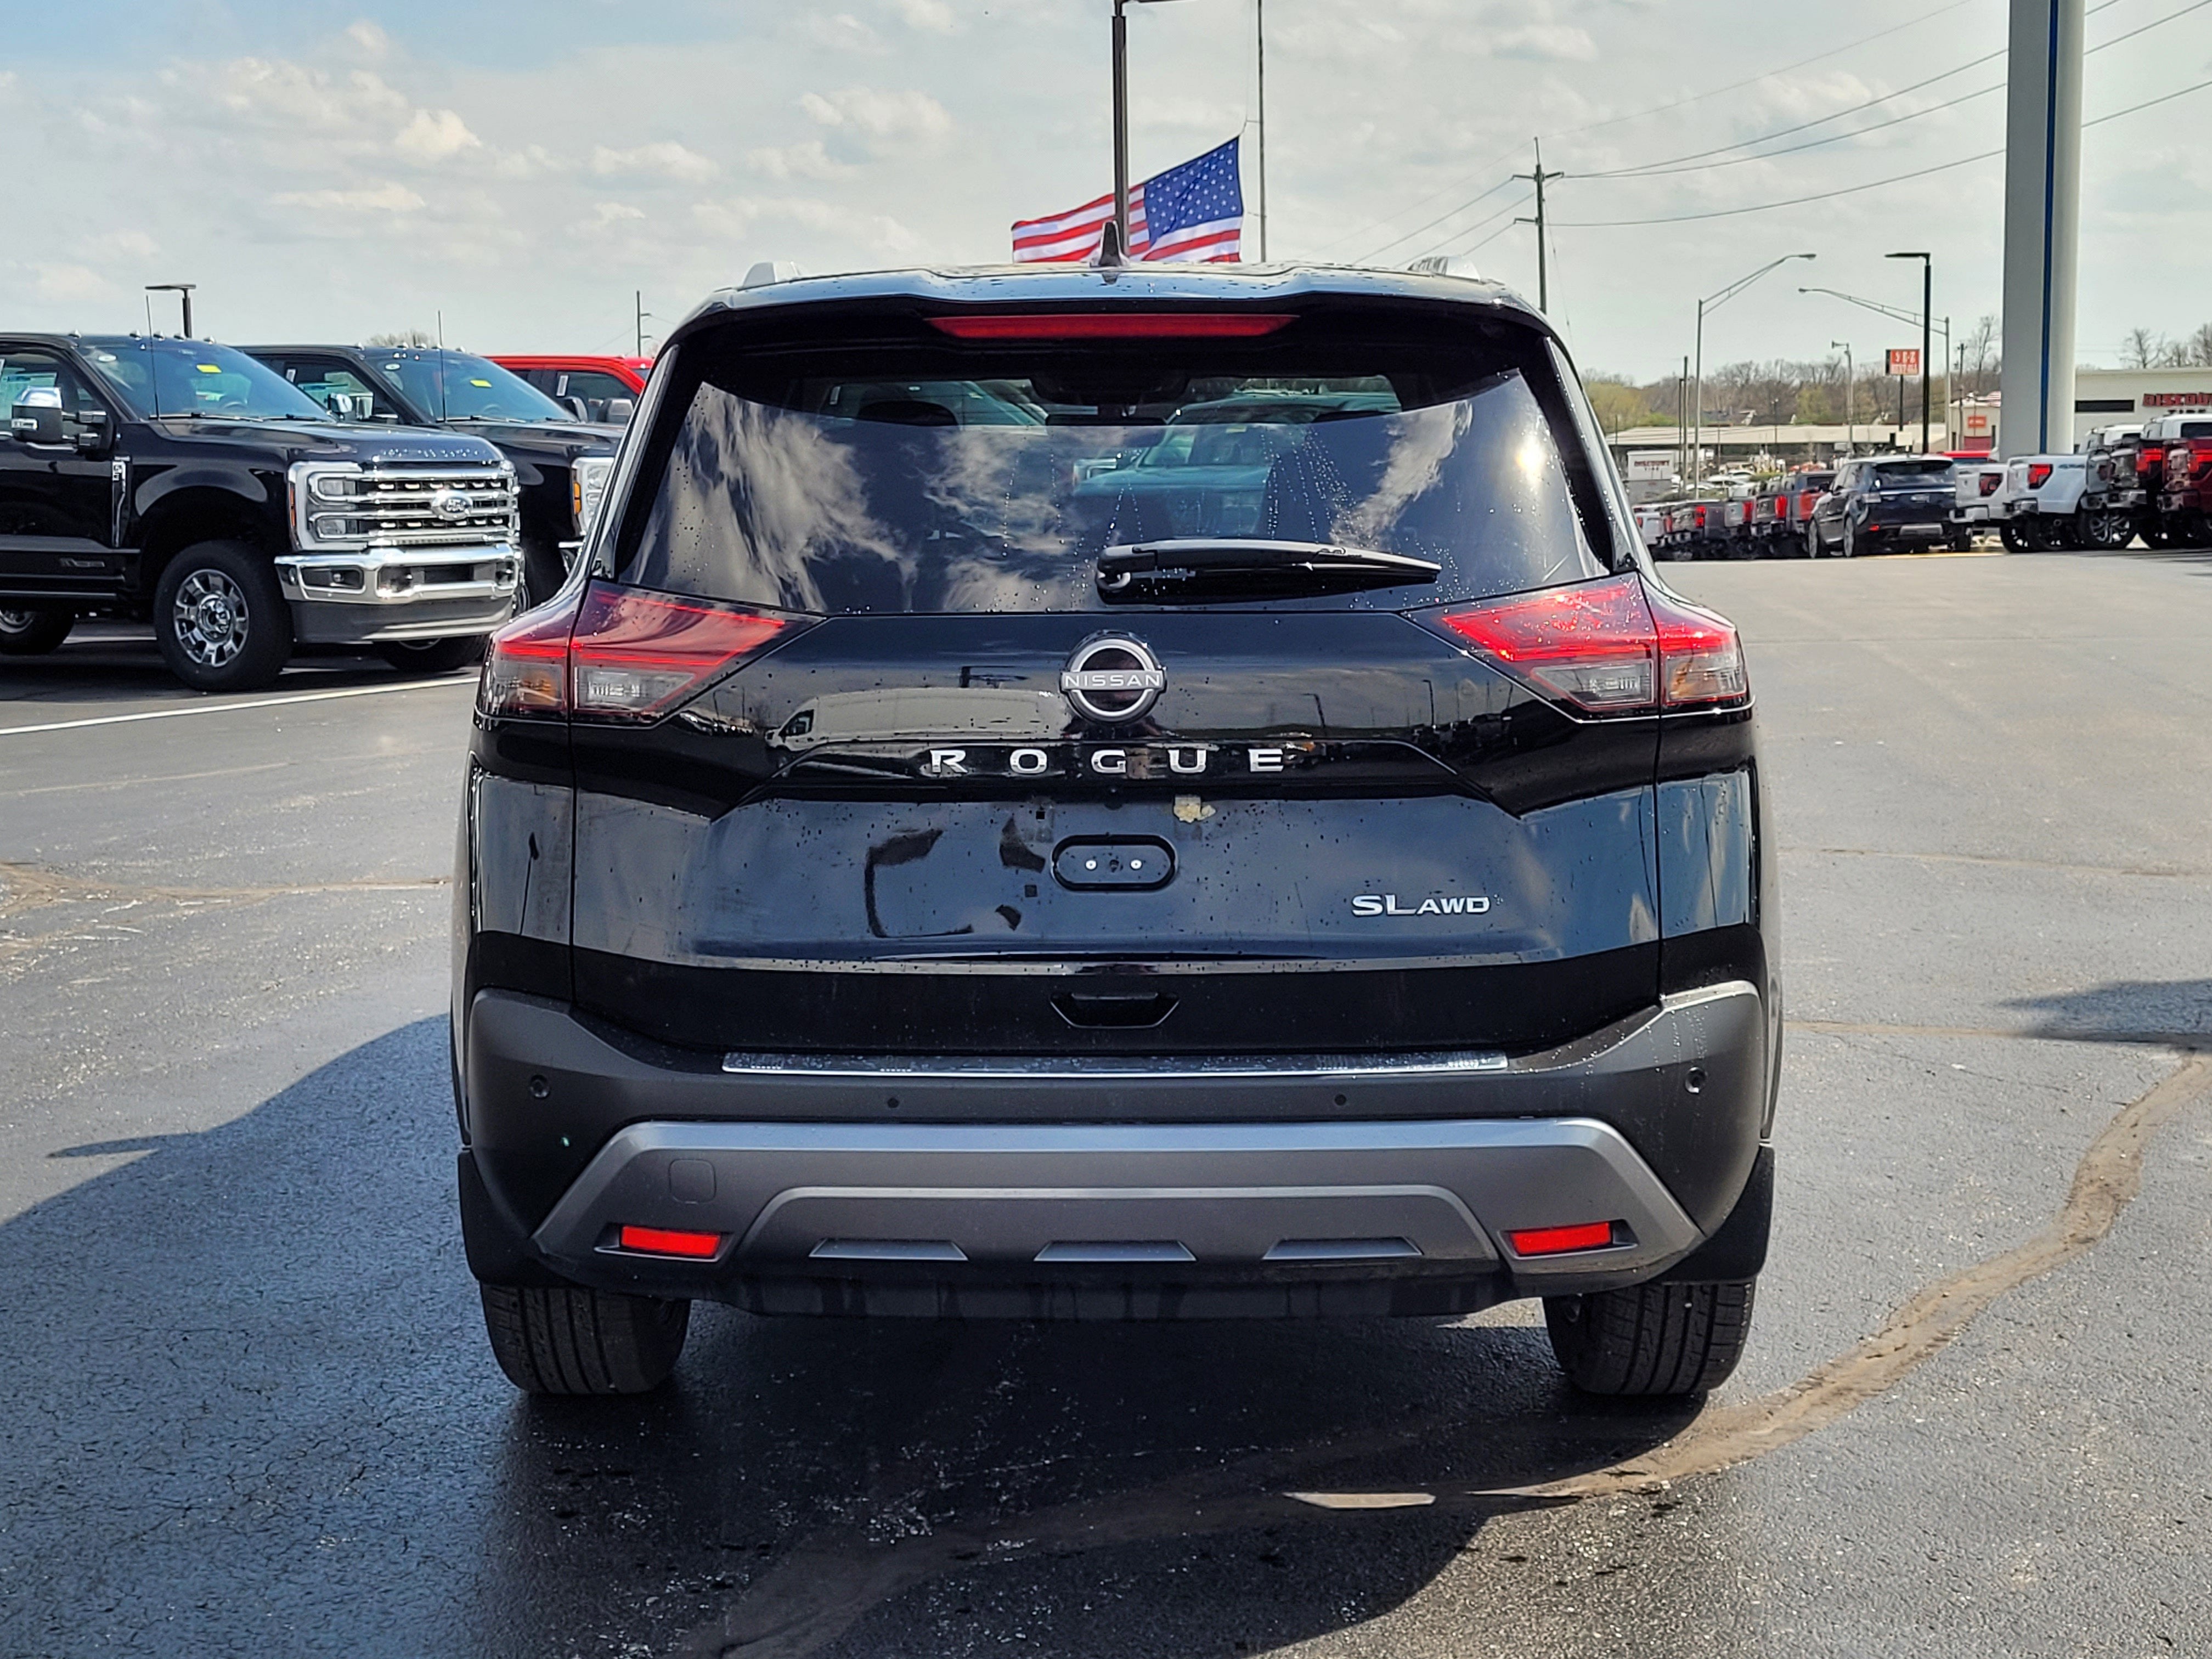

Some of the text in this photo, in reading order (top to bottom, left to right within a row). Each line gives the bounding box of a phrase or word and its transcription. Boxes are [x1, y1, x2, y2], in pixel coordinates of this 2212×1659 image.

[2143, 392, 2212, 407] DISCOU
[1065, 674, 1160, 687] NISSAN
[930, 748, 1284, 775] ROGUE
